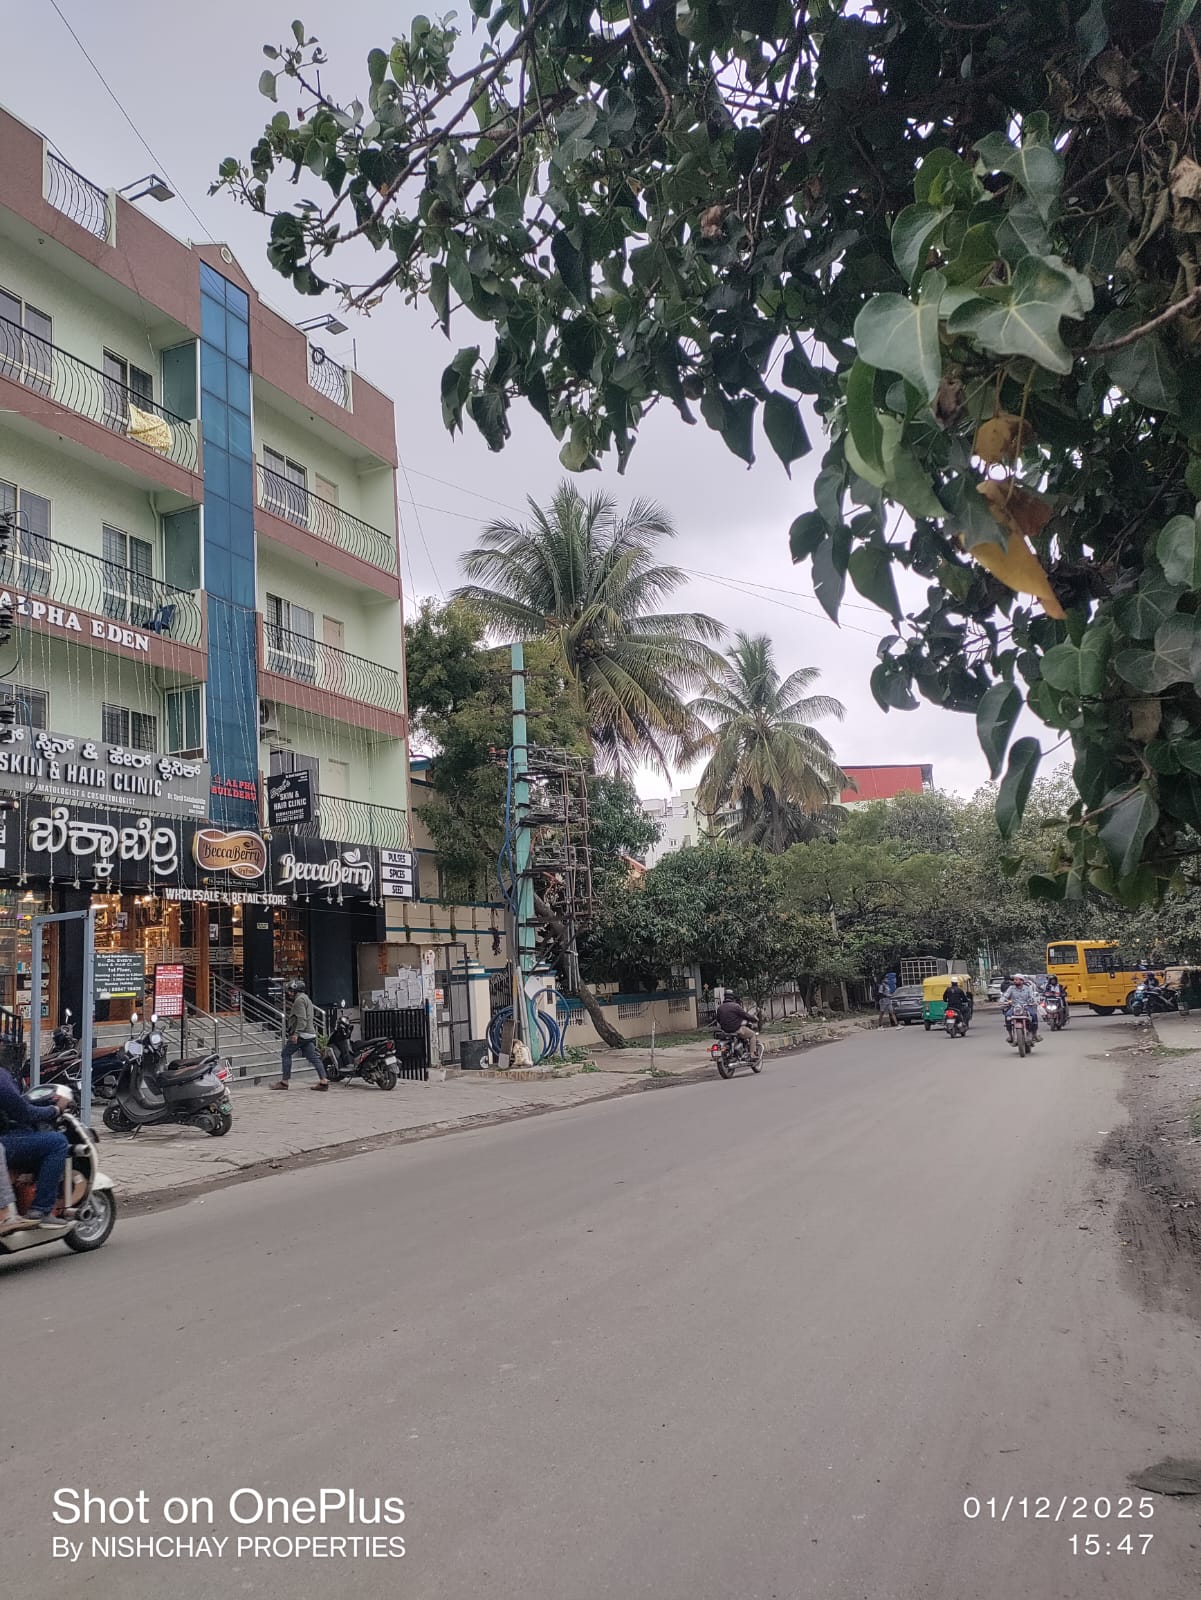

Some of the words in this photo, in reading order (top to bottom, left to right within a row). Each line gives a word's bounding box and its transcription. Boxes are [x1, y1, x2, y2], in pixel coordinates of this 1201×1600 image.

[0, 591, 82, 631] ALPHA
[91, 619, 149, 652] EDEN
[36, 732, 75, 760] ಸ್ಕಿನ್
[83, 743, 99, 760] &
[109, 747, 152, 768] ಹೇರ್
[158, 758, 200, 781] ಕ್ಲಿನಿಕ್
[0, 751, 43, 777] SKIN
[49, 761, 60, 780] &
[67, 763, 106, 787] HAIR
[113, 772, 162, 797] CLINIC
[210, 785, 257, 801] BUILDERS
[225, 778, 257, 792] ALPHA
[280, 791, 294, 801] SKIN
[295, 790, 300, 798] &
[273, 801, 287, 810] HAIR
[288, 798, 307, 808] CLINIC
[203, 843, 261, 865] BeccaBerry
[388, 852, 406, 864] PULSES
[274, 853, 373, 892] BeccaBerry
[389, 870, 406, 880] SPICES
[165, 888, 220, 902] WHOLESALE
[222, 891, 231, 902] &
[232, 891, 260, 905] RETAIL
[262, 894, 287, 906] STORE
[391, 885, 404, 895] SEED
